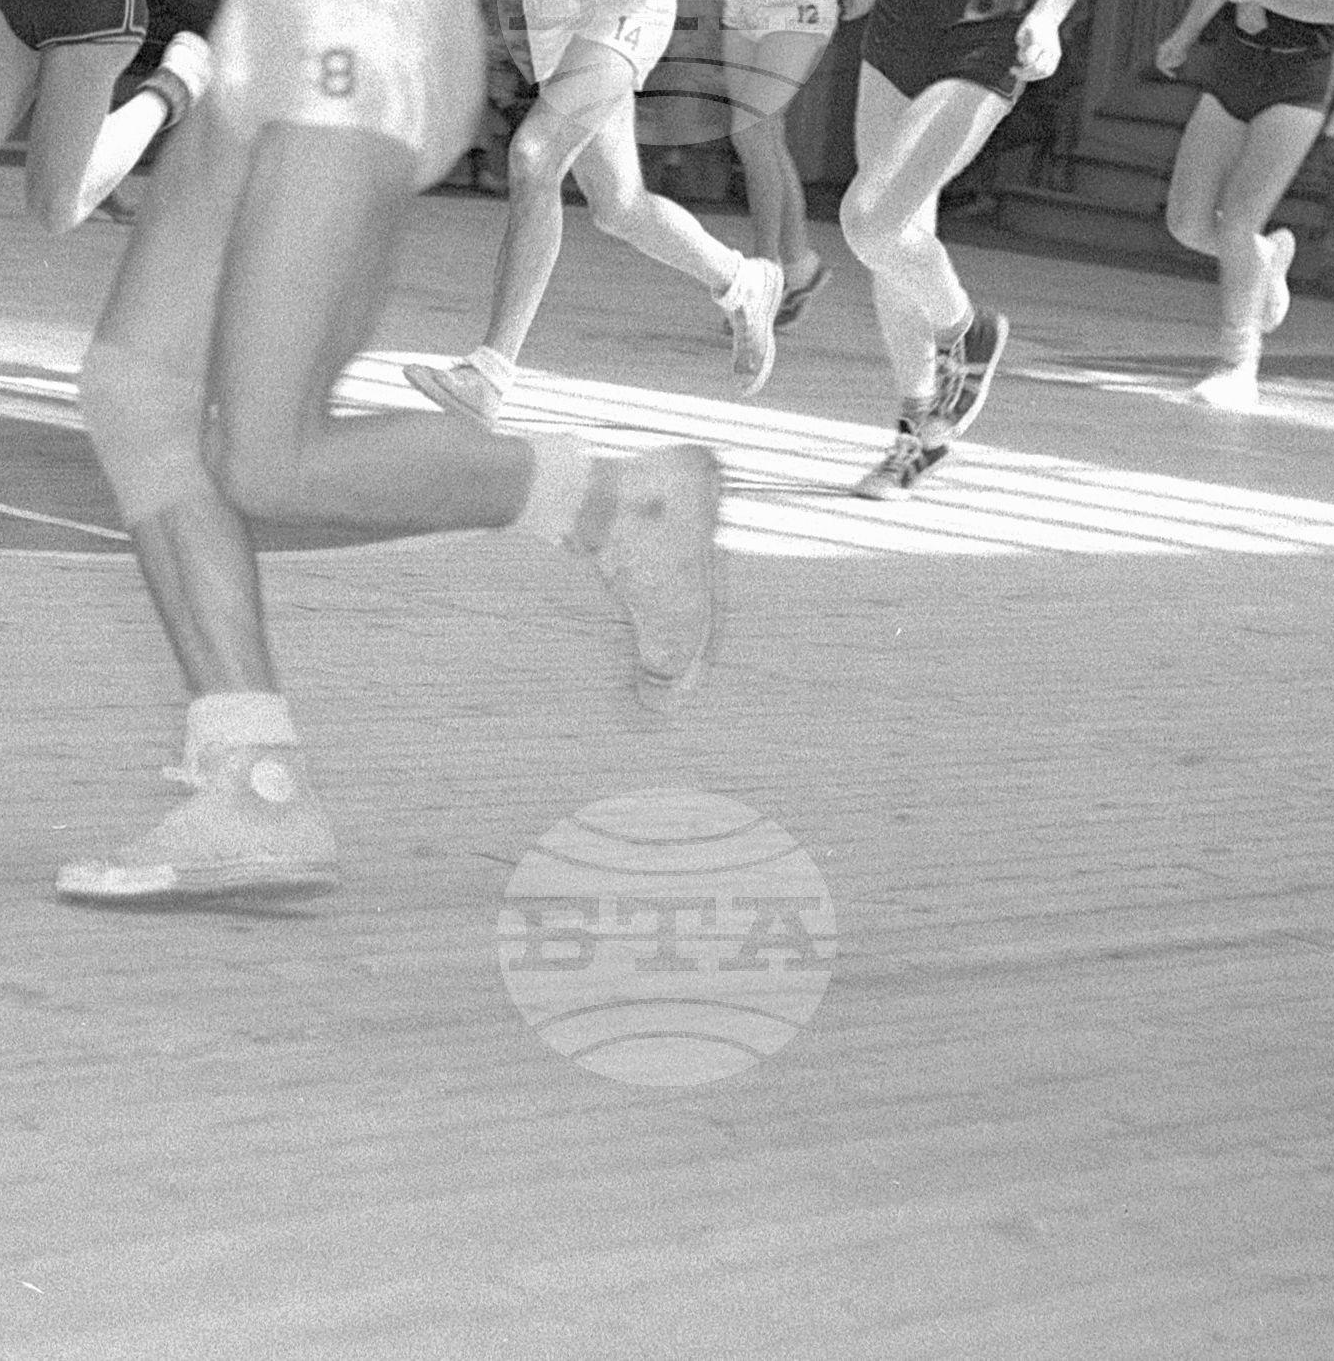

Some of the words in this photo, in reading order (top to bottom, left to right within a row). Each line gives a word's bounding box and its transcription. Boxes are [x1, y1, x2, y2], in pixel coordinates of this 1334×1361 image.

[796, 3, 820, 25] 12
[613, 15, 643, 52] 14
[320, 47, 357, 99] 8
